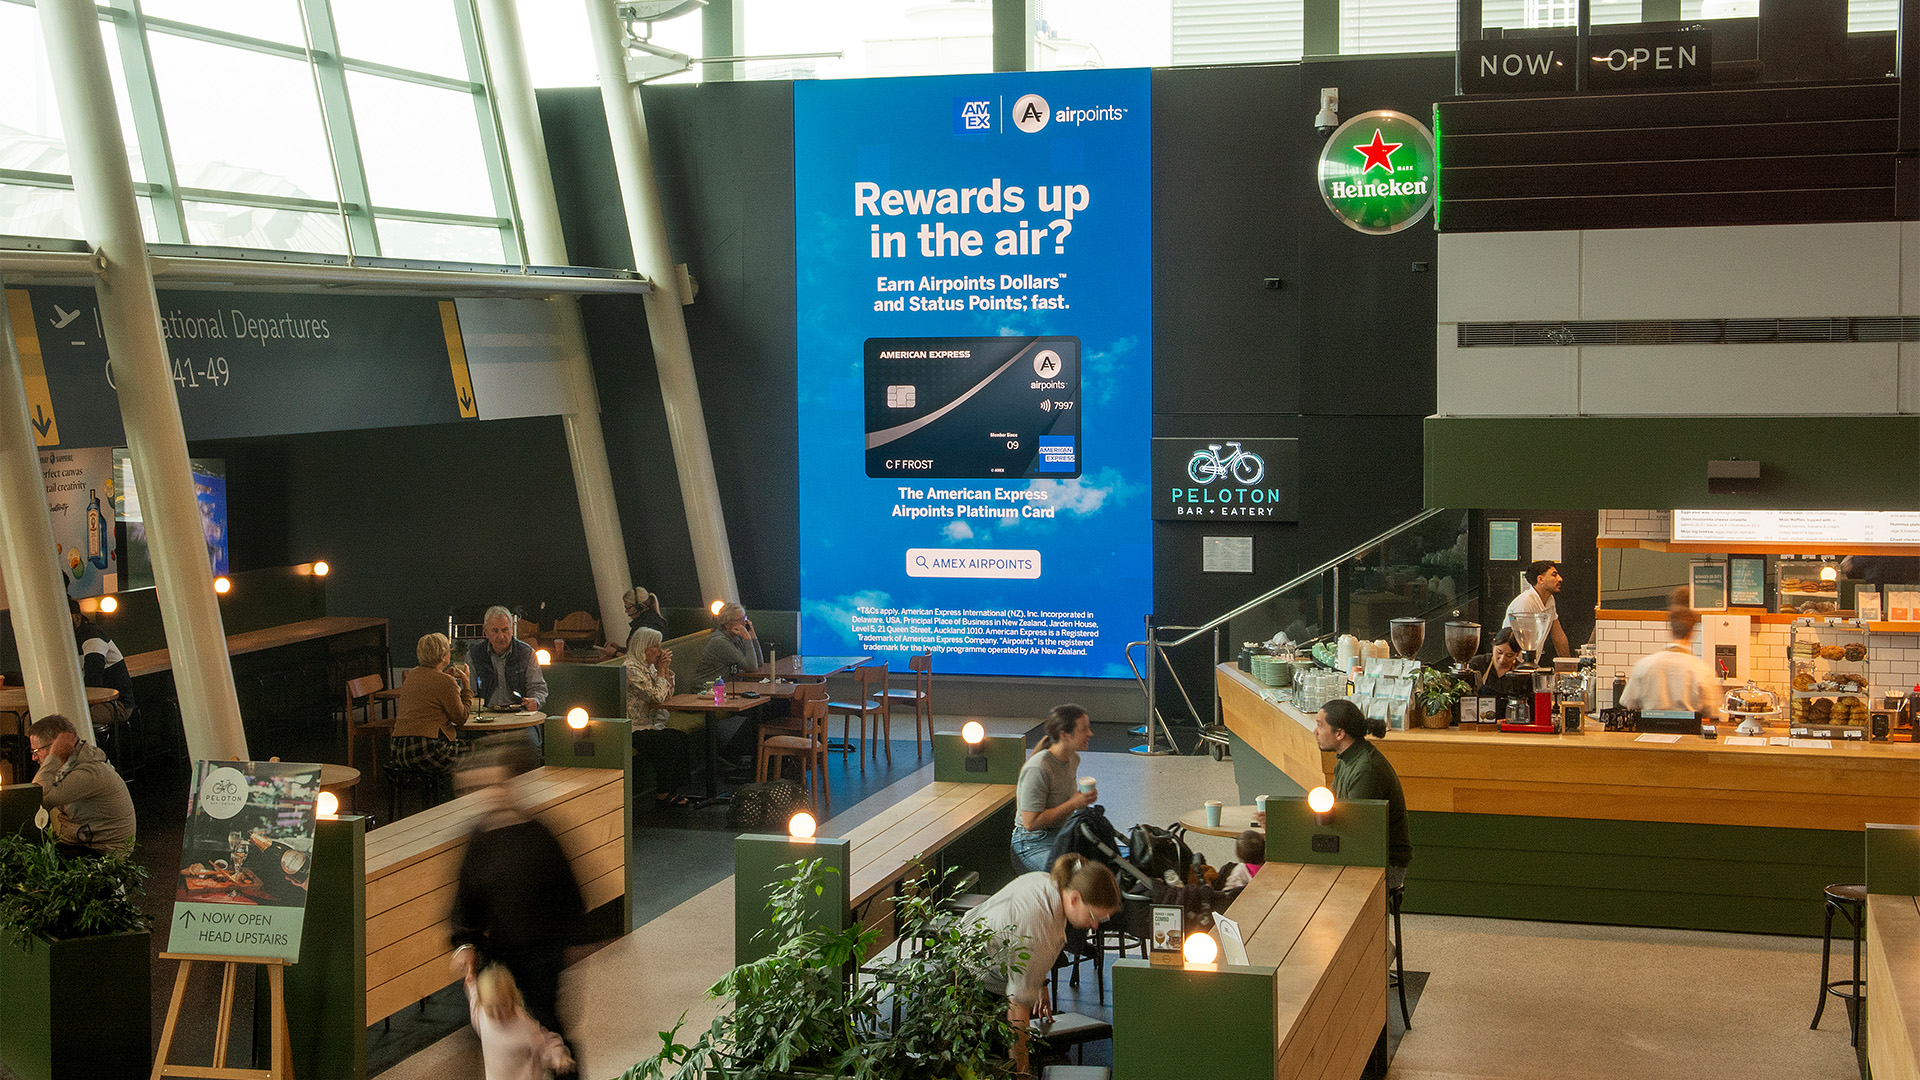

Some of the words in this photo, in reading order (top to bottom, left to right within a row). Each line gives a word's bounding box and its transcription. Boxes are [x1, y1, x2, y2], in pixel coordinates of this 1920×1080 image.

[1480, 51, 1554, 77] NOW
[1607, 45, 1696, 71] OPEN
[854, 179, 1025, 217] Rewards
[1038, 183, 1090, 220] up
[871, 224, 906, 258] in
[917, 222, 983, 258] the
[994, 219, 1073, 255] air?
[877, 276, 915, 292] Earn
[918, 275, 996, 295] Airpoints
[873, 296, 904, 312] and
[908, 296, 965, 311] Status
[1031, 294, 1070, 310] fast.
[93, 307, 228, 339] Iational
[231, 309, 330, 347] Departures
[880, 350, 927, 359] AMERICAN
[929, 350, 970, 359] EXPRESS
[172, 356, 230, 388] 41-49
[1053, 401, 1074, 410] 7997
[1006, 440, 1019, 450] 09
[1039, 446, 1073, 454] AMERICAN
[885, 459, 894, 469] C
[895, 459, 902, 469] F
[902, 459, 933, 469] FROST
[1045, 454, 1075, 462] EXPRESS
[43, 468, 61, 478] erfect
[62, 468, 83, 477] canvas
[57, 481, 86, 492] creativity
[898, 487, 924, 500] The
[927, 487, 993, 500] American
[994, 488, 1048, 503] Express
[1171, 488, 1280, 503] PELOTON
[891, 505, 954, 520] Airpoints
[957, 505, 1019, 518] Platinum
[1021, 506, 1055, 519] Card
[1177, 506, 1203, 515] BAR
[1221, 507, 1274, 516] EATERY
[932, 558, 967, 570] AMEX
[969, 558, 1033, 570] AIRPOINTS
[934, 608, 961, 617] Express
[962, 608, 1006, 617] International
[1040, 610, 1085, 619] Incorporated
[903, 617, 933, 626] Principal
[962, 618, 993, 626] Business
[886, 626, 909, 634] Queen
[1020, 628, 1047, 637] Express
[1061, 629, 1099, 638] Registered
[936, 635, 963, 644] Express
[1058, 639, 1094, 647] registered
[863, 643, 899, 651] trademark
[946, 645, 986, 654] programme
[988, 646, 1019, 655] operated
[1020, 647, 1029, 655] by
[205, 794, 242, 802] PELOTON
[201, 912, 236, 924] NOW
[237, 913, 272, 926] OPEN
[198, 930, 232, 943] HEAD
[235, 931, 289, 946] UPSTAIRS
